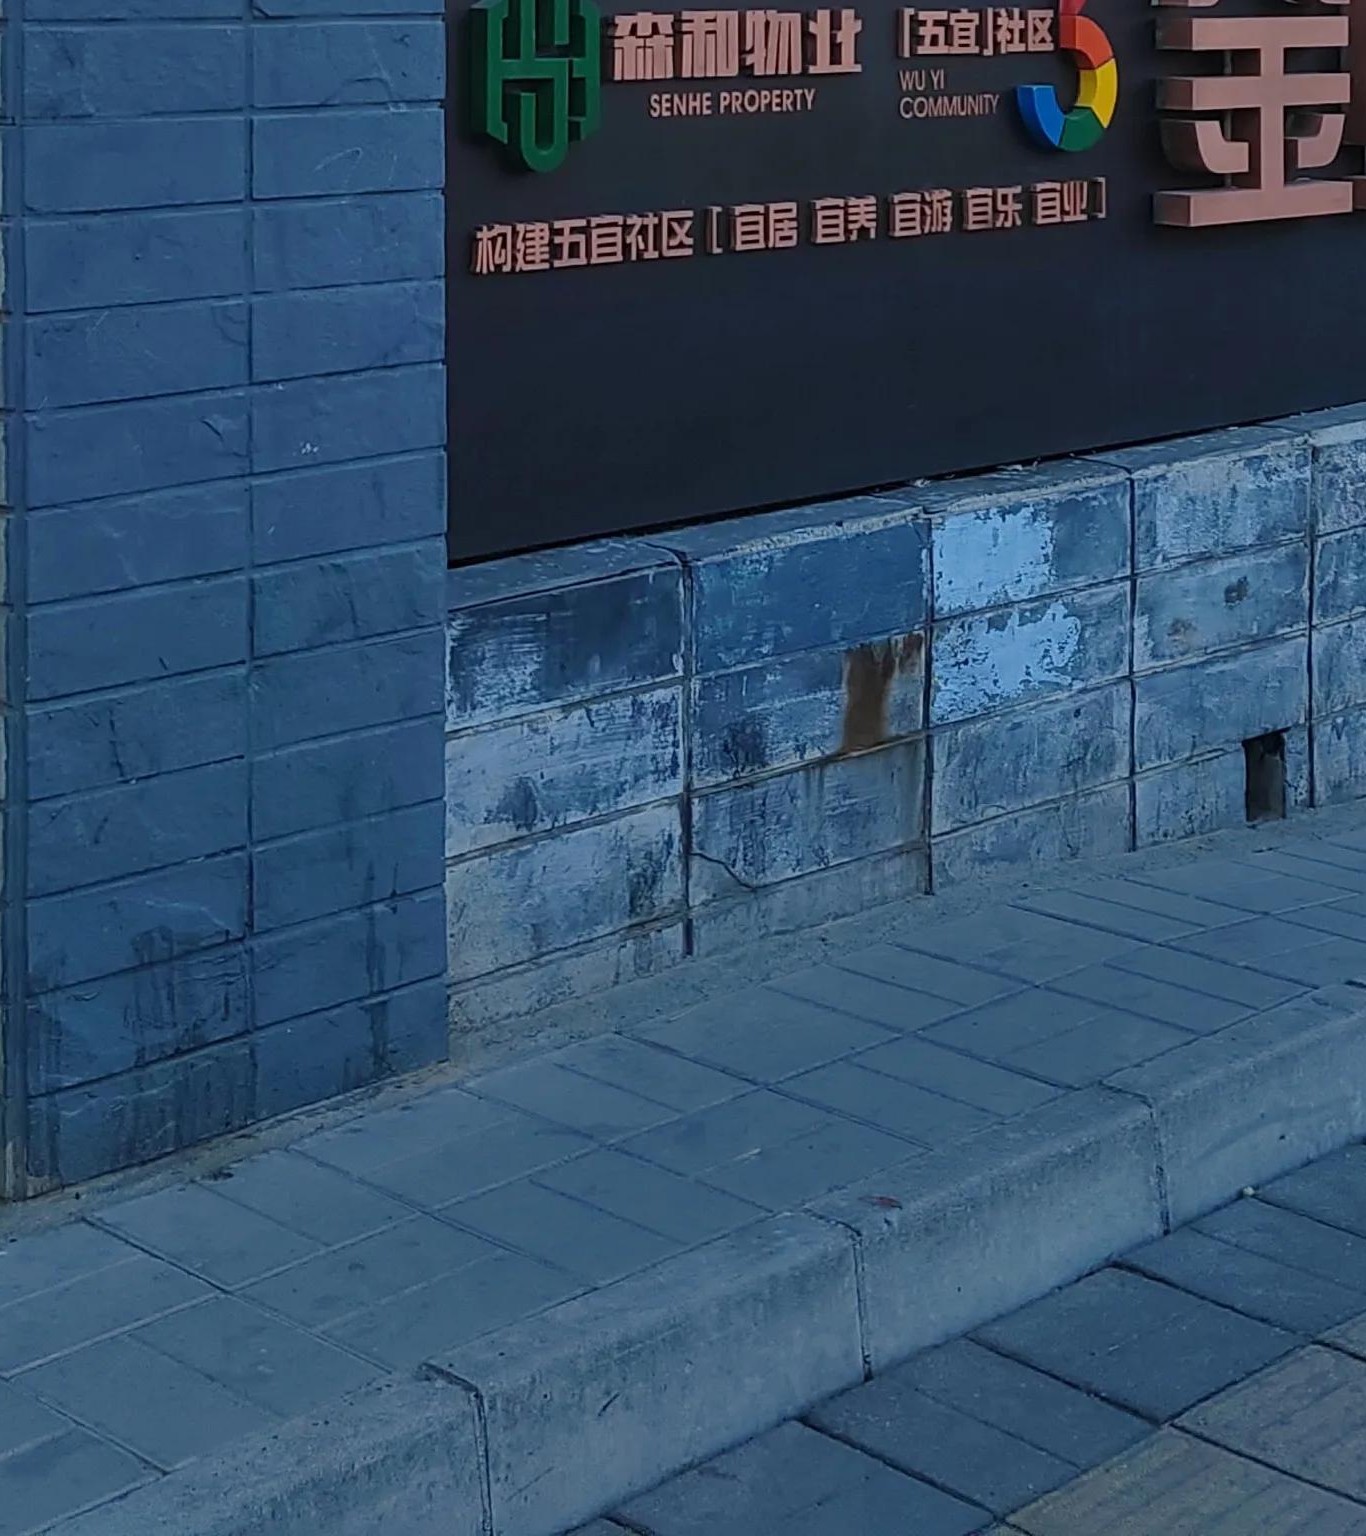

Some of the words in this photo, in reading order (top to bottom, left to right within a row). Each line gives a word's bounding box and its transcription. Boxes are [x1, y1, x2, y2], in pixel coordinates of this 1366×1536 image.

[612, 9, 863, 81] 森和物业
[899, 70, 927, 91] WU
[930, 69, 945, 90] YI
[649, 92, 713, 118] SENHE
[719, 87, 816, 115] PROPERTY
[899, 94, 1000, 119] COMMUNITY
